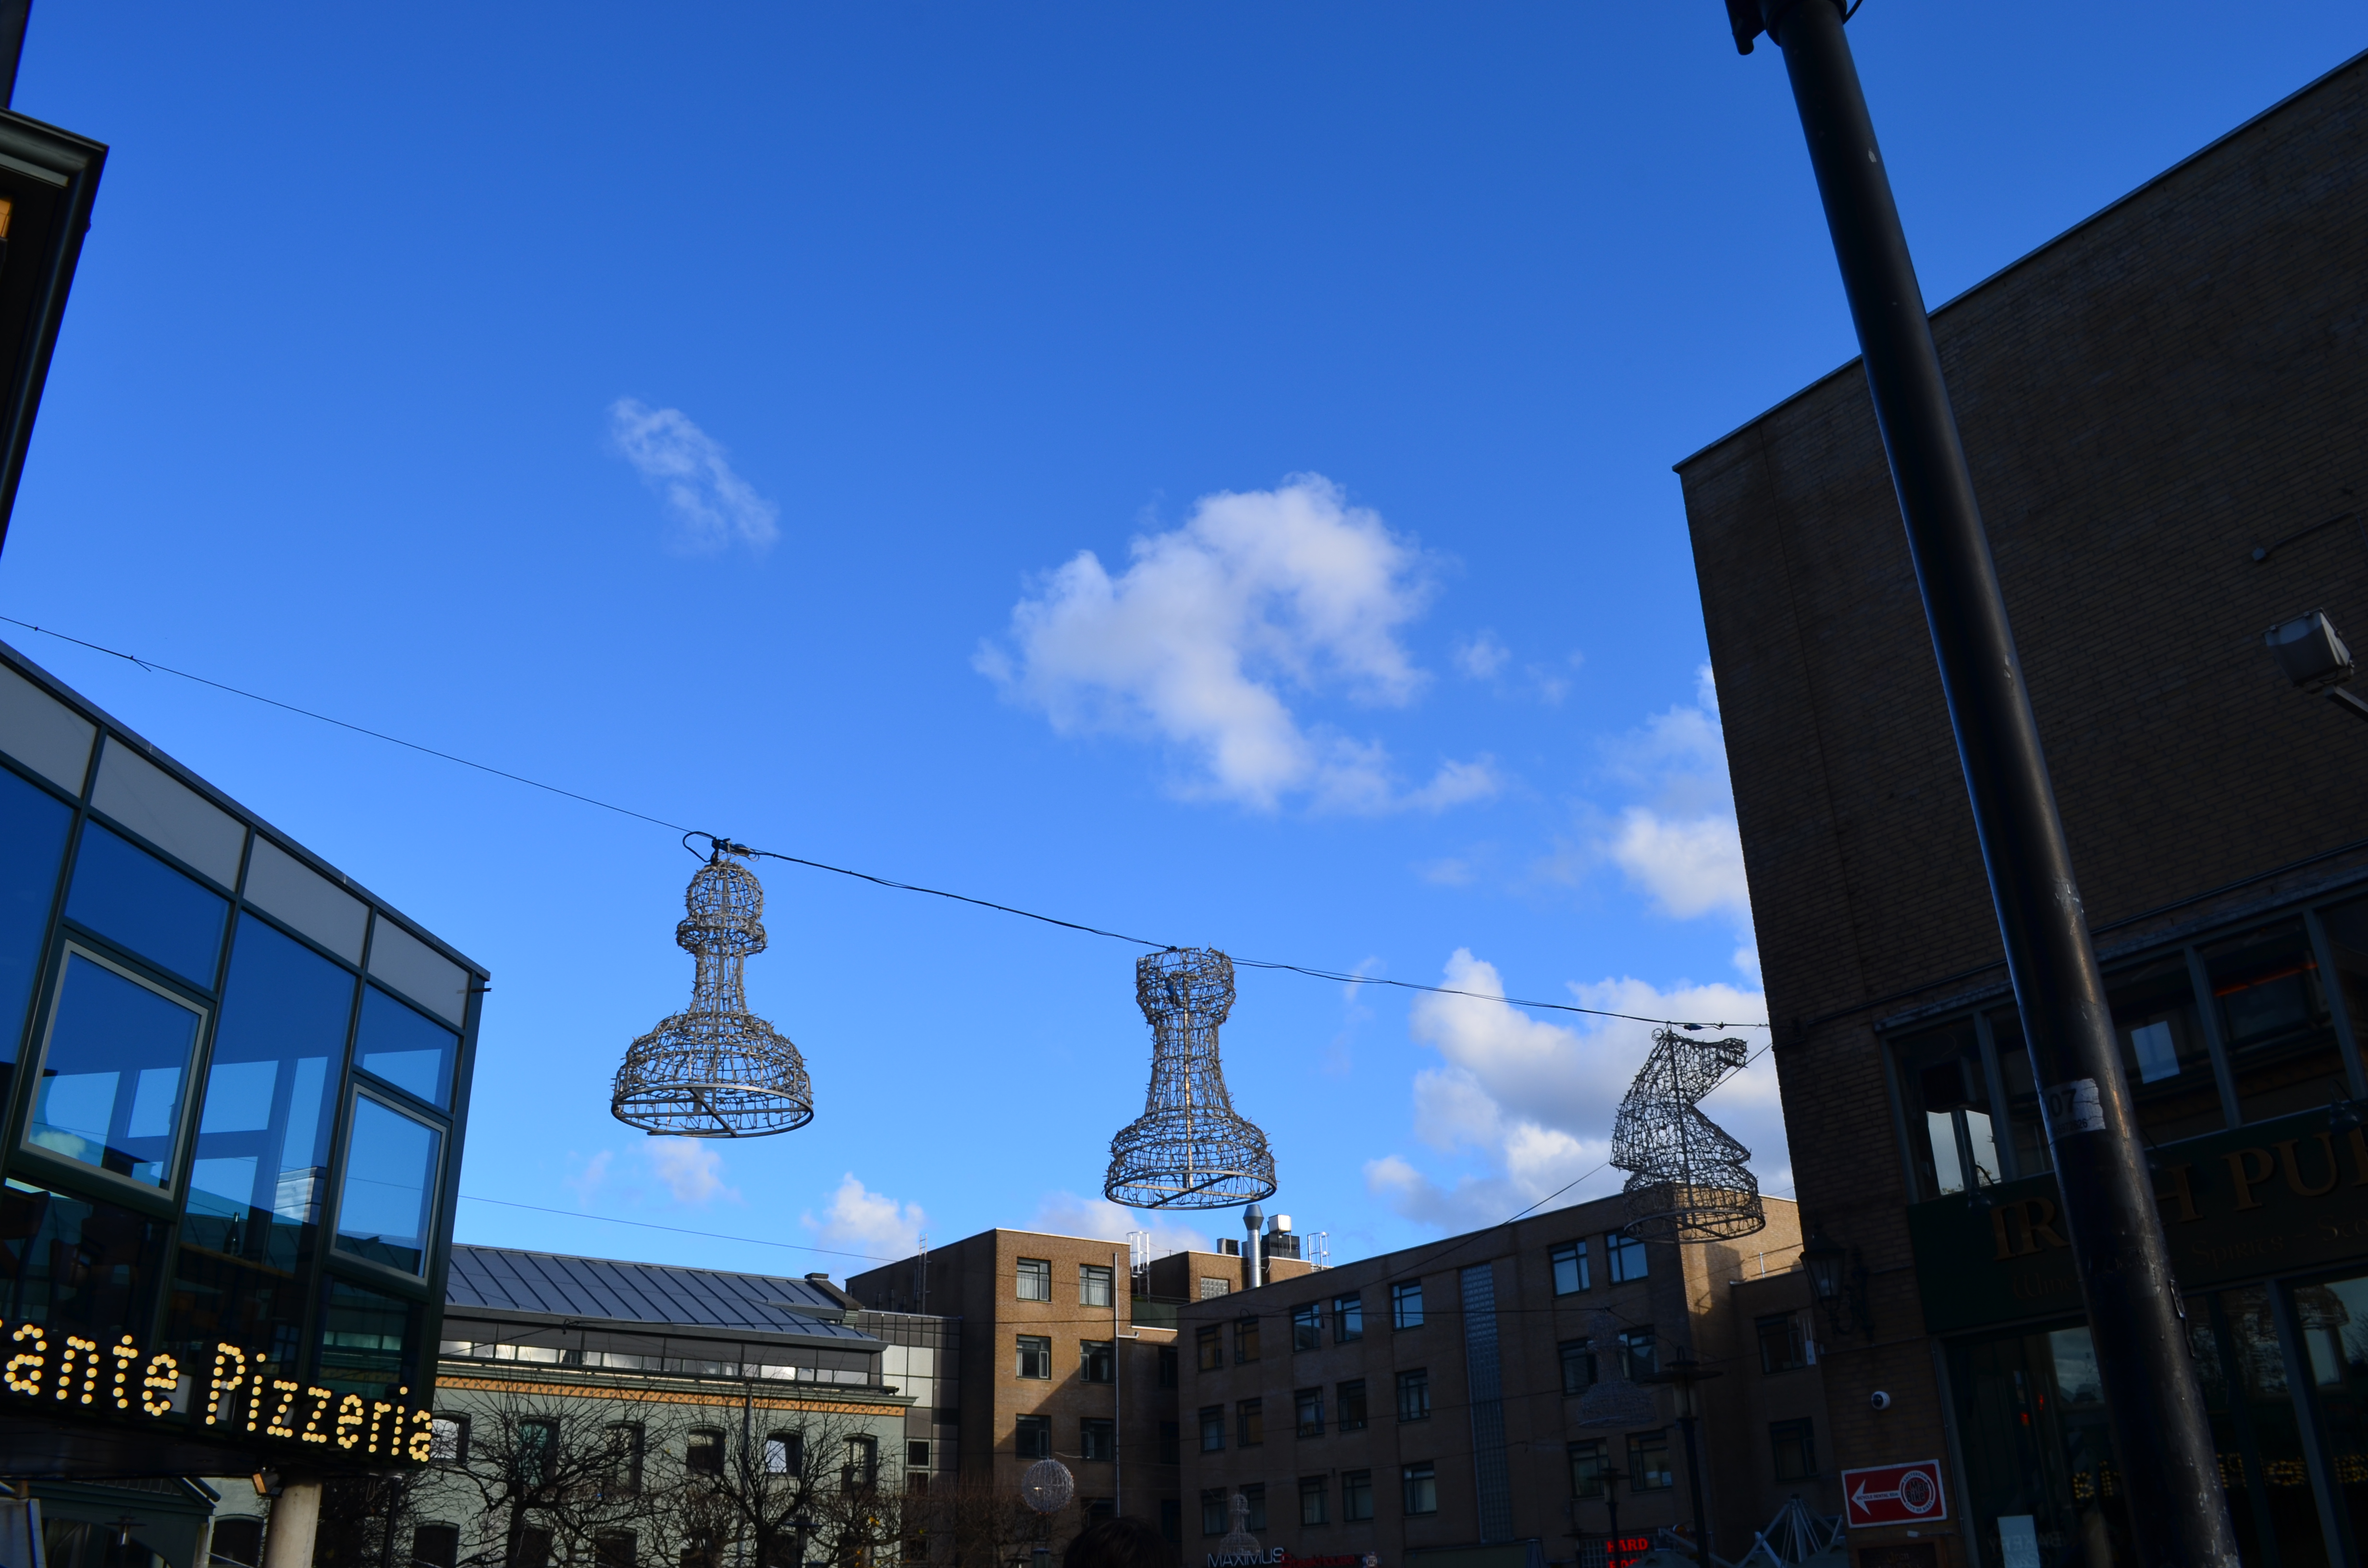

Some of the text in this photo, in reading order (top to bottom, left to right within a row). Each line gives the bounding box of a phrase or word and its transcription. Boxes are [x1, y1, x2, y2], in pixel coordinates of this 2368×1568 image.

[0, 1318, 433, 1462] ante Pizzeria
[1903, 1471, 1928, 1482] AMSTERDAM
[1910, 1480, 1929, 1492] Mac
[1906, 1489, 1925, 1503] Bike
[1905, 1503, 1915, 1511] CITY
[1923, 1500, 1933, 1511] BIKES
[1208, 1547, 1285, 1568] MAXIMUS
